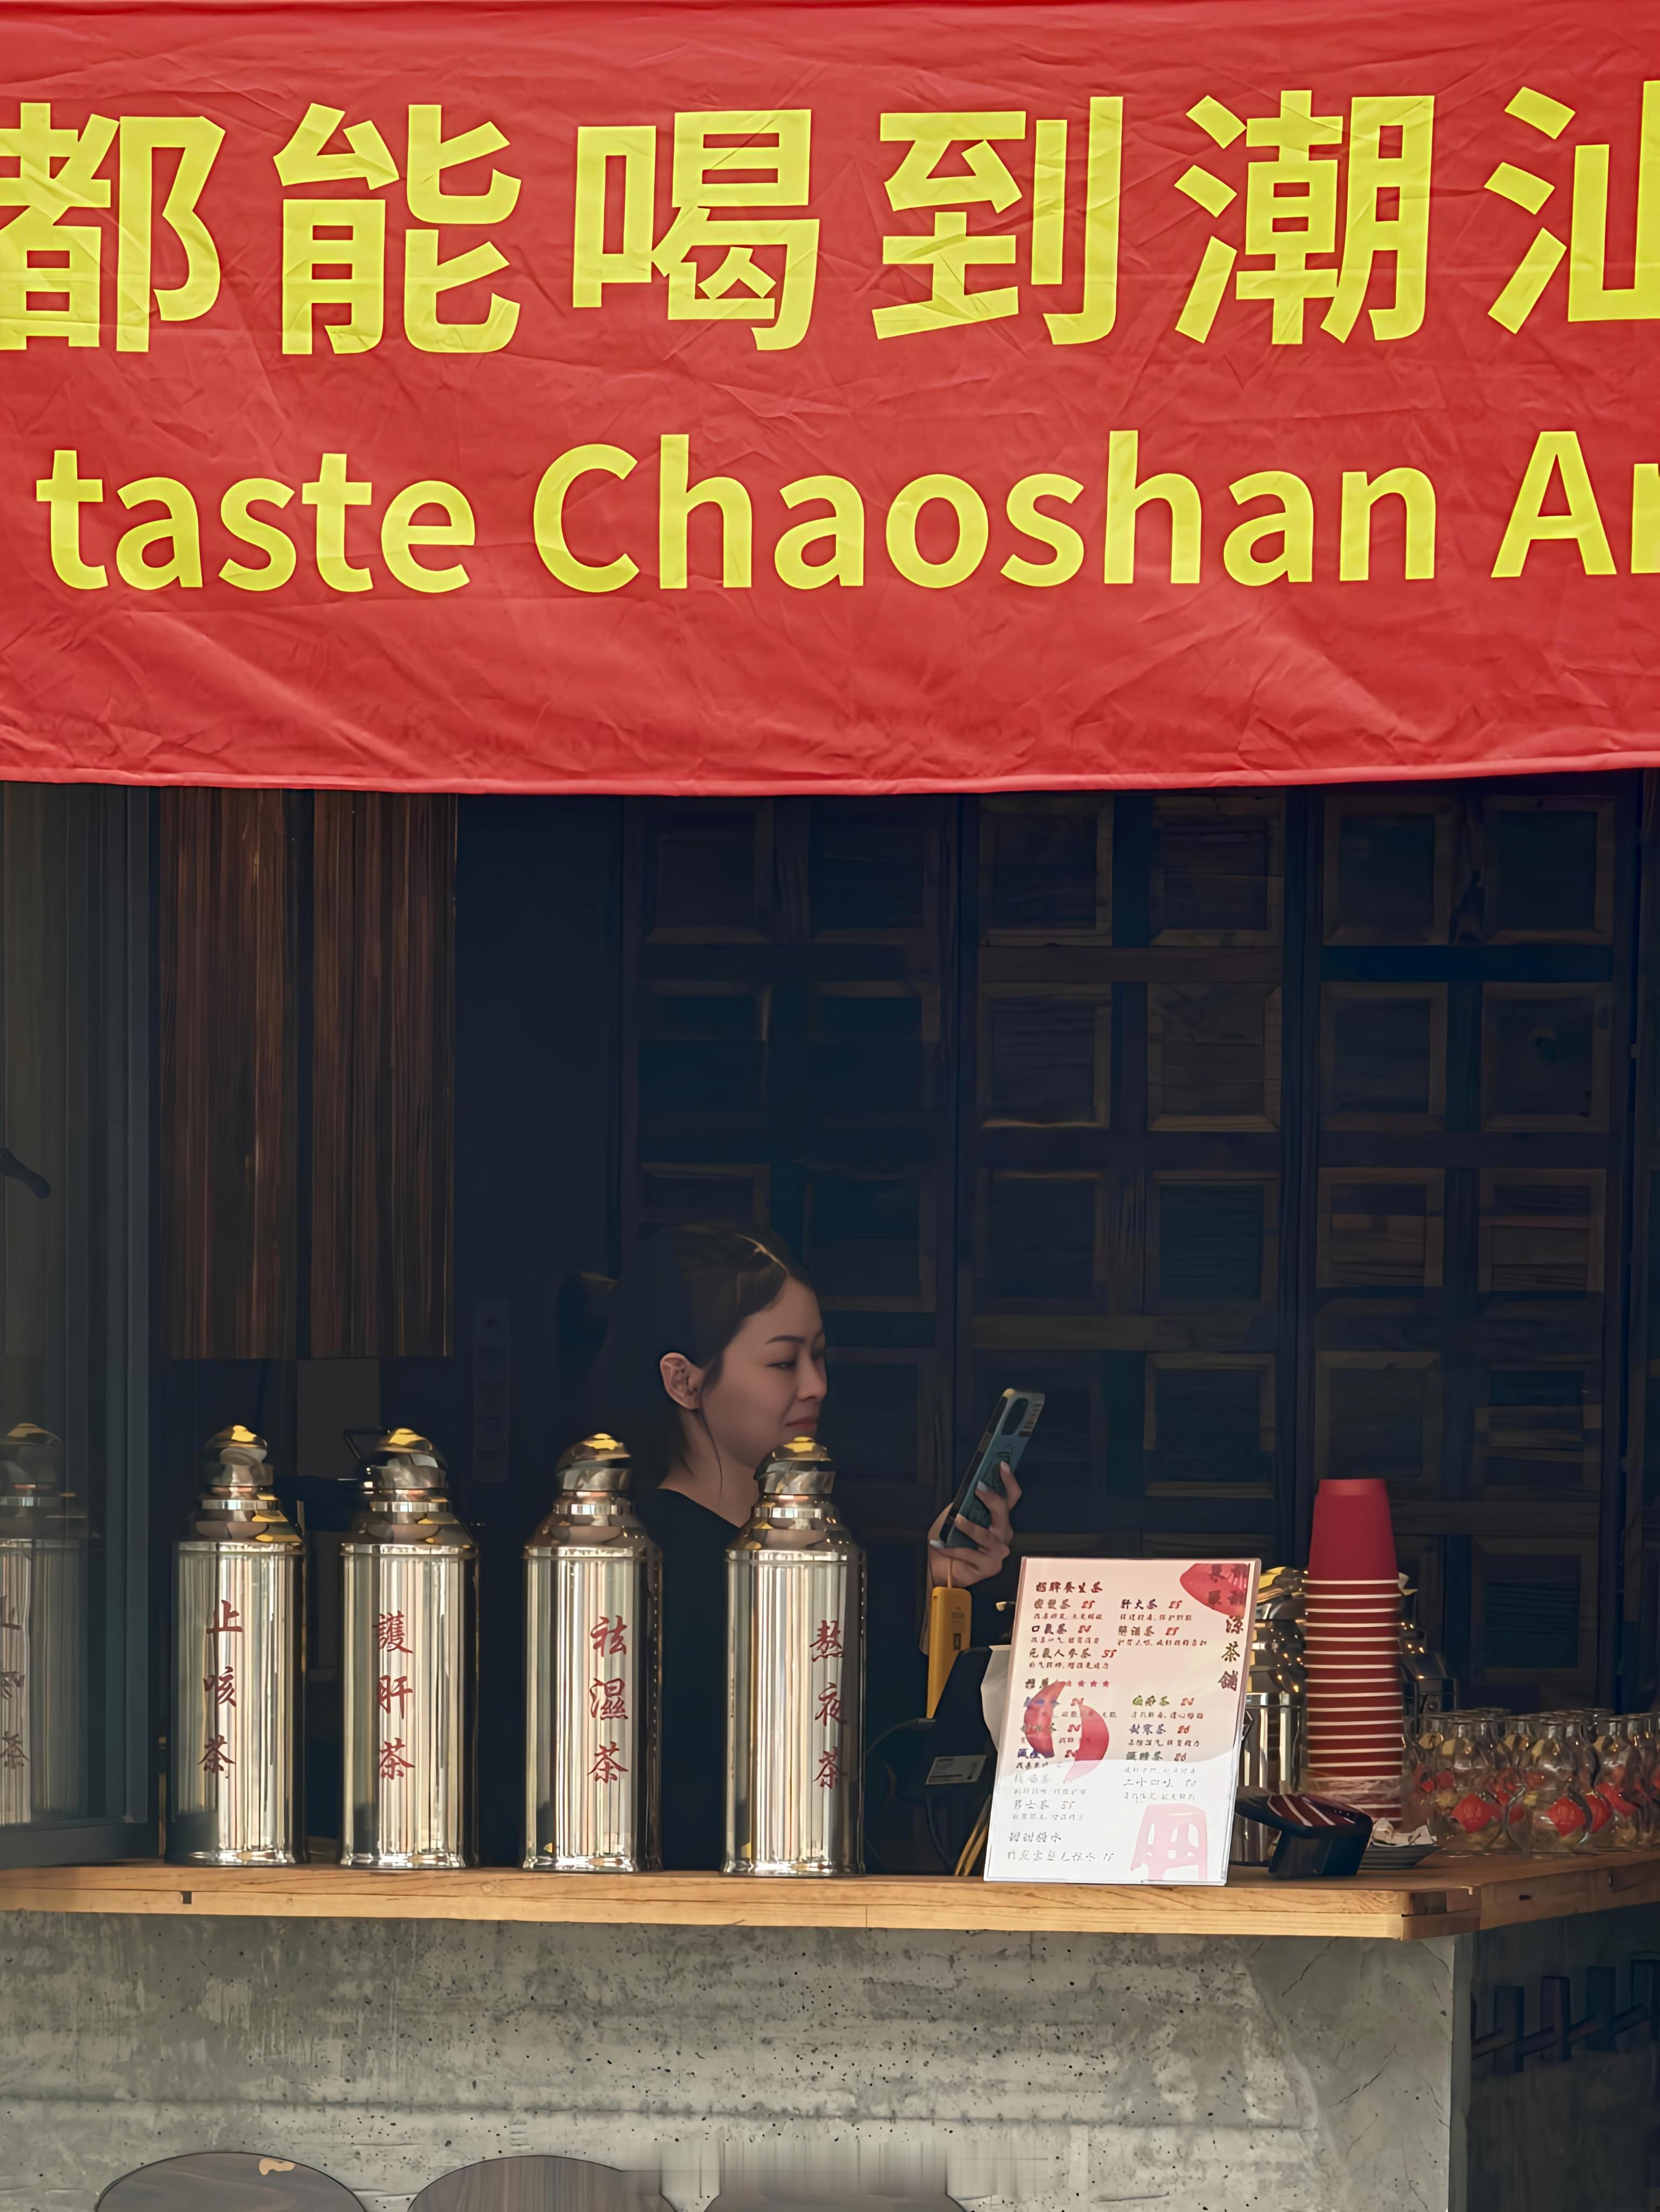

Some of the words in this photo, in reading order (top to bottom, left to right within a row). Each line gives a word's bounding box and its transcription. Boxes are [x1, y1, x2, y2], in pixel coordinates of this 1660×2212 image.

[0, 81, 1660, 354] 都能喝到潮汕
[36, 450, 475, 593] taste
[534, 430, 1436, 592] Chaoshan
[1491, 431, 1660, 577] A
[197, 1600, 243, 1773] 止咳茶
[372, 1610, 415, 1781] 護肝茶
[809, 1620, 849, 1789] 熬夜茶
